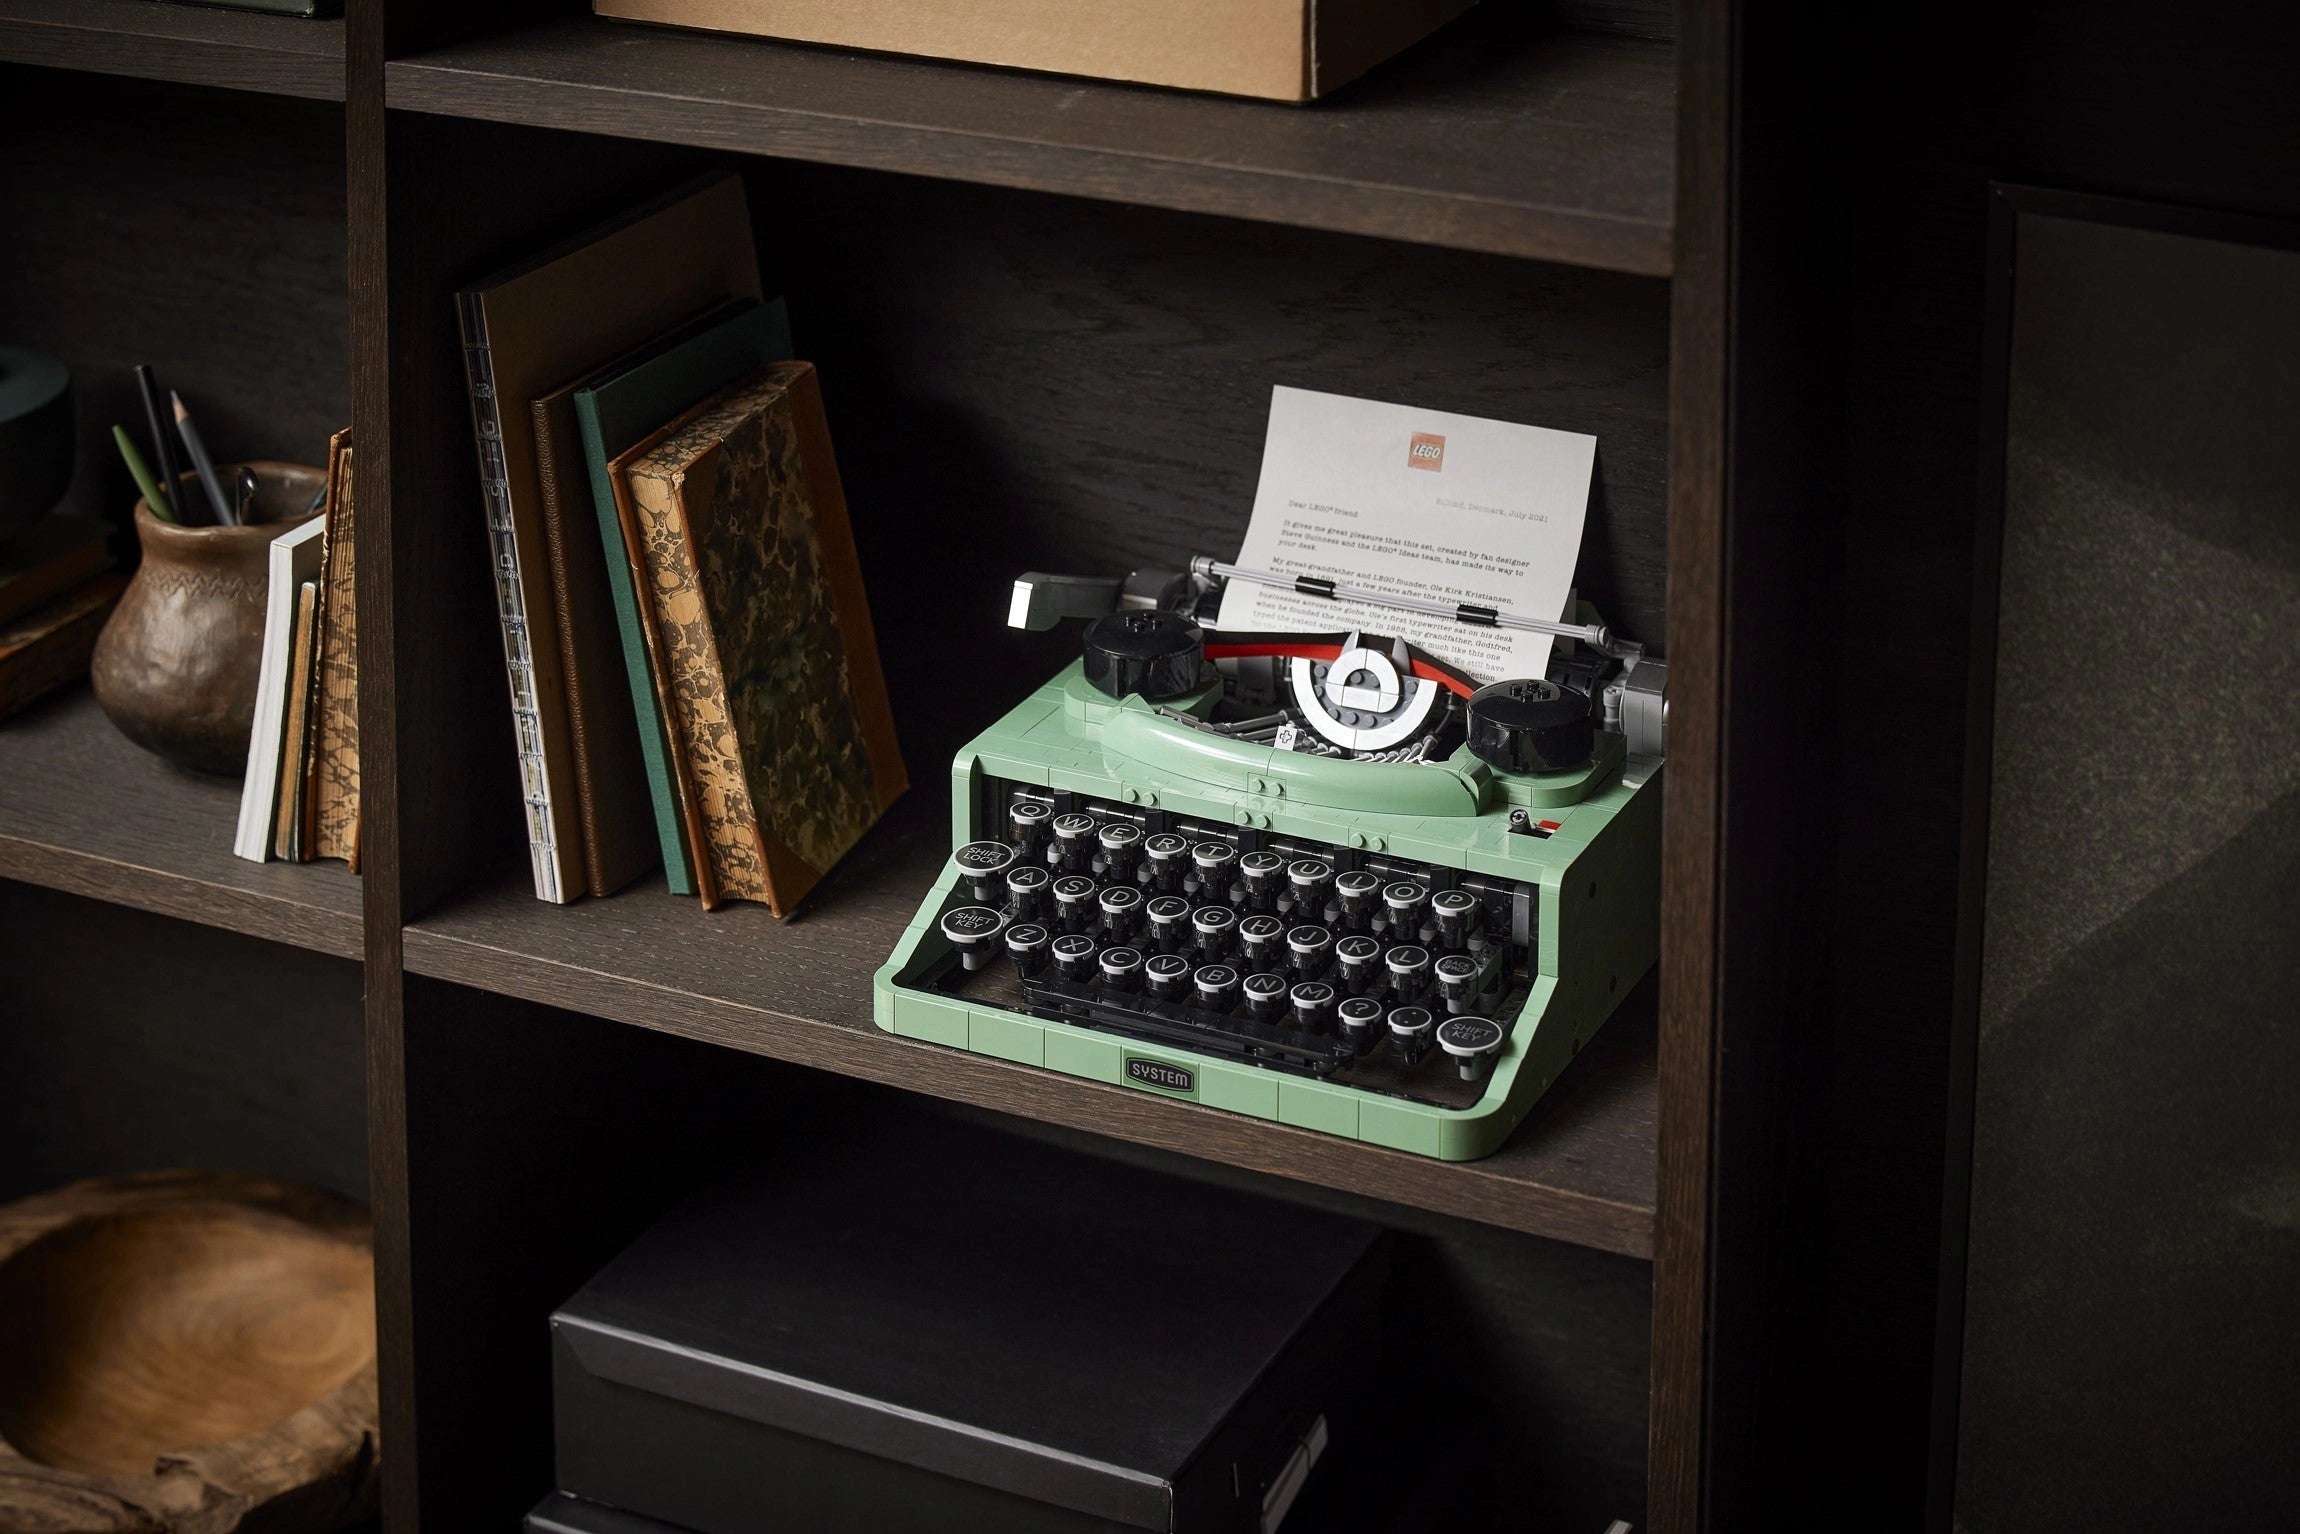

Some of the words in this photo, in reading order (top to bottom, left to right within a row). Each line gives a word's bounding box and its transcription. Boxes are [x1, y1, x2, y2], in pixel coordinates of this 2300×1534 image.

[1413, 444, 1441, 459] LEGO
[1288, 500, 1307, 509] Dear
[1334, 508, 1359, 518] friend
[1508, 510, 1526, 520] July
[1528, 513, 1548, 523] 2021
[1292, 522, 1312, 530] gives
[1327, 527, 1348, 537] great
[1349, 530, 1383, 543] pleasure
[1385, 537, 1401, 546] that
[1403, 539, 1419, 548] this
[1421, 543, 1435, 552] set,
[1437, 546, 1467, 557] created
[1469, 551, 1479, 560] by
[1480, 553, 1494, 562] fan
[1495, 556, 1530, 568] designer
[1298, 541, 1317, 551] desk.
[1281, 529, 1303, 538] Steve
[1304, 533, 1339, 545] Guinness
[1341, 539, 1356, 548] and
[1357, 542, 1370, 551] the
[1398, 549, 1420, 559] Ideas
[1421, 553, 1443, 564] team,
[1445, 557, 1460, 566] has
[1462, 560, 1483, 570] made
[1485, 564, 1496, 572] its
[1498, 567, 1514, 576] way
[1269, 566, 1284, 574] was
[1362, 582, 1376, 590] few
[1377, 585, 1400, 594] years
[1402, 588, 1422, 598] after
[1423, 592, 1437, 600] the
[1438, 595, 1482, 607] typewriter
[1273, 557, 1284, 565] My
[1356, 572, 1371, 581] and
[1373, 574, 1395, 584] LEGO
[1396, 578, 1428, 590] founder,
[1430, 584, 1443, 592] Ole
[1445, 587, 1462, 596] Kirk
[1465, 590, 1514, 605] Kristiansen,
[1256, 601, 1276, 610] when
[1288, 606, 1320, 617] founded
[1375, 622, 1384, 630] In
[1409, 629, 1423, 637] my
[1423, 632, 1473, 646] grandfather,
[1475, 640, 1514, 654] Godtfred,
[1302, 600, 1327, 609] across
[1389, 616, 1408, 624] first
[1409, 618, 1453, 632] typewriter
[1454, 626, 1467, 635] sat
[1480, 632, 1493, 640] his
[1494, 634, 1514, 643] desk
[1252, 609, 1276, 619] typed
[1277, 614, 1290, 622] the
[1291, 617, 1317, 627] patent
[1427, 643, 1449, 652] much
[1451, 646, 1467, 655] like
[1468, 649, 1485, 658] this
[1486, 653, 1501, 661] one
[1454, 656, 1465, 666] We
[1466, 660, 1484, 669] still
[1485, 663, 1505, 673] have
[1021, 805, 1041, 817] Q
[1062, 816, 1089, 829] W
[1110, 827, 1129, 839] E
[1156, 838, 1176, 850] R
[968, 846, 1005, 860] SHIFT
[1209, 846, 1224, 856] T
[963, 851, 997, 865] LOCK
[1255, 855, 1273, 866] Y
[1300, 863, 1320, 874] U
[1016, 871, 1034, 884] A
[1064, 880, 1083, 892] S
[1394, 886, 1415, 898] O
[1109, 891, 1130, 902] D
[1444, 894, 1463, 906] P
[1157, 901, 1178, 912] F
[954, 912, 994, 925] SHIFT
[1203, 911, 1224, 922] G
[955, 918, 983, 929] KEY
[1250, 920, 1273, 933] H
[1016, 929, 1038, 941] Z
[1298, 931, 1317, 942] J
[1061, 938, 1085, 951] X
[1348, 940, 1368, 954] K
[1110, 952, 1130, 964] C
[1398, 950, 1412, 963] L
[1160, 958, 1180, 971] V
[1206, 969, 1225, 981] B
[1253, 977, 1277, 991] N
[1299, 985, 1323, 999] M
[1354, 1002, 1369, 1015] ?
[1451, 1023, 1493, 1037] SHIFT
[1451, 1031, 1482, 1042] KEY
[1132, 1063, 1189, 1088] SYSTEM
